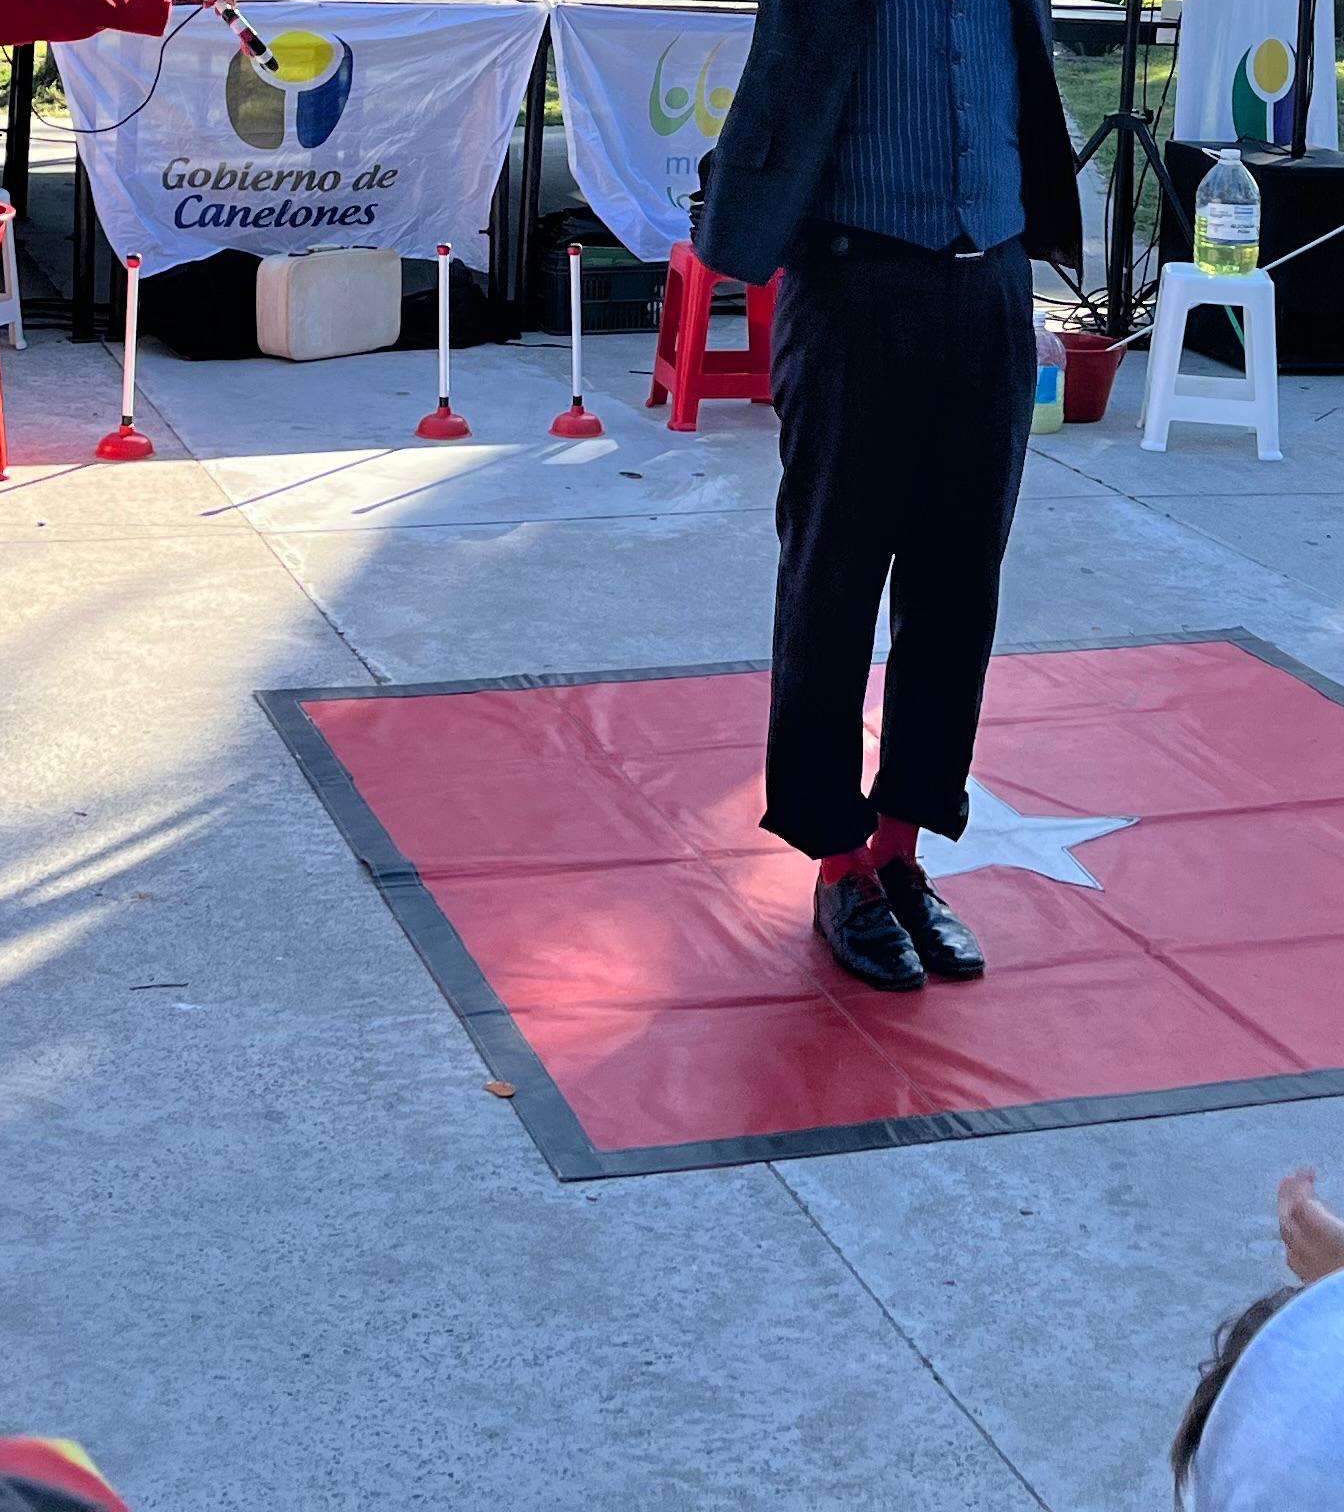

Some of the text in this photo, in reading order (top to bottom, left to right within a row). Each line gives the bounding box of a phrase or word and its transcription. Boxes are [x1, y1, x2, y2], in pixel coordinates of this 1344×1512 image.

[161, 156, 399, 193] Gobierno de
[173, 194, 379, 230] Canelones
